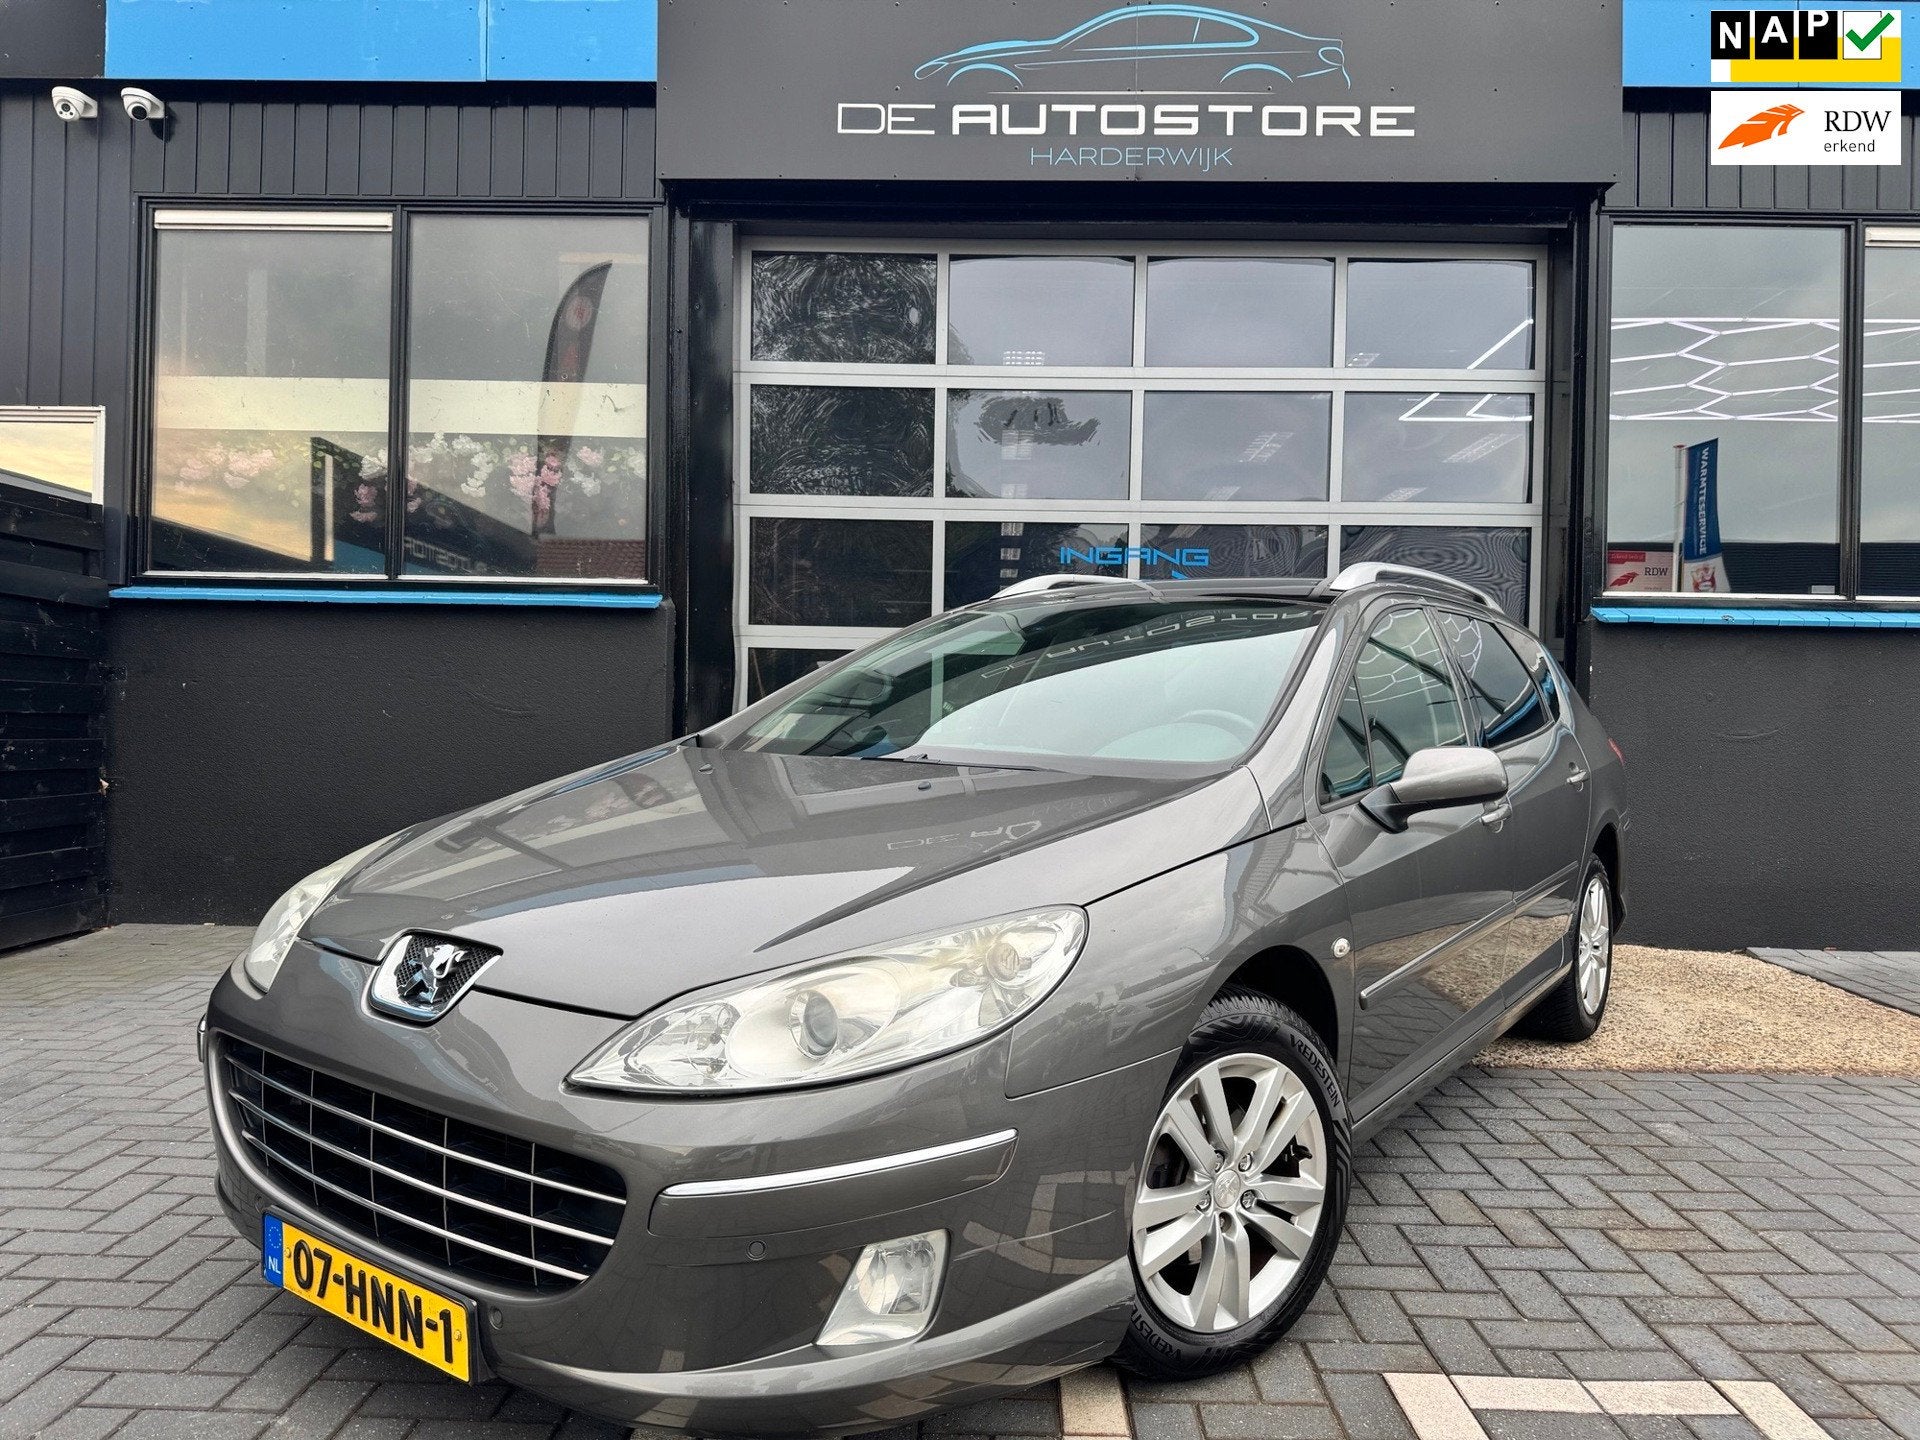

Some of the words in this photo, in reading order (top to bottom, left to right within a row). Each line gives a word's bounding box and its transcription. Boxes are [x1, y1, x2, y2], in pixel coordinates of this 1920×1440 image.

[837, 102, 936, 135] DE
[952, 104, 1416, 137] AUTOSTORE
[1030, 147, 1233, 172] HARDERWIJK
[1060, 546, 1210, 567] INGANG
[1644, 567, 1669, 577] RDW
[1290, 1033, 1341, 1108] VREDESTEIN
[268, 1256, 281, 1274] NL
[293, 1239, 453, 1364] 07-HNN-1
